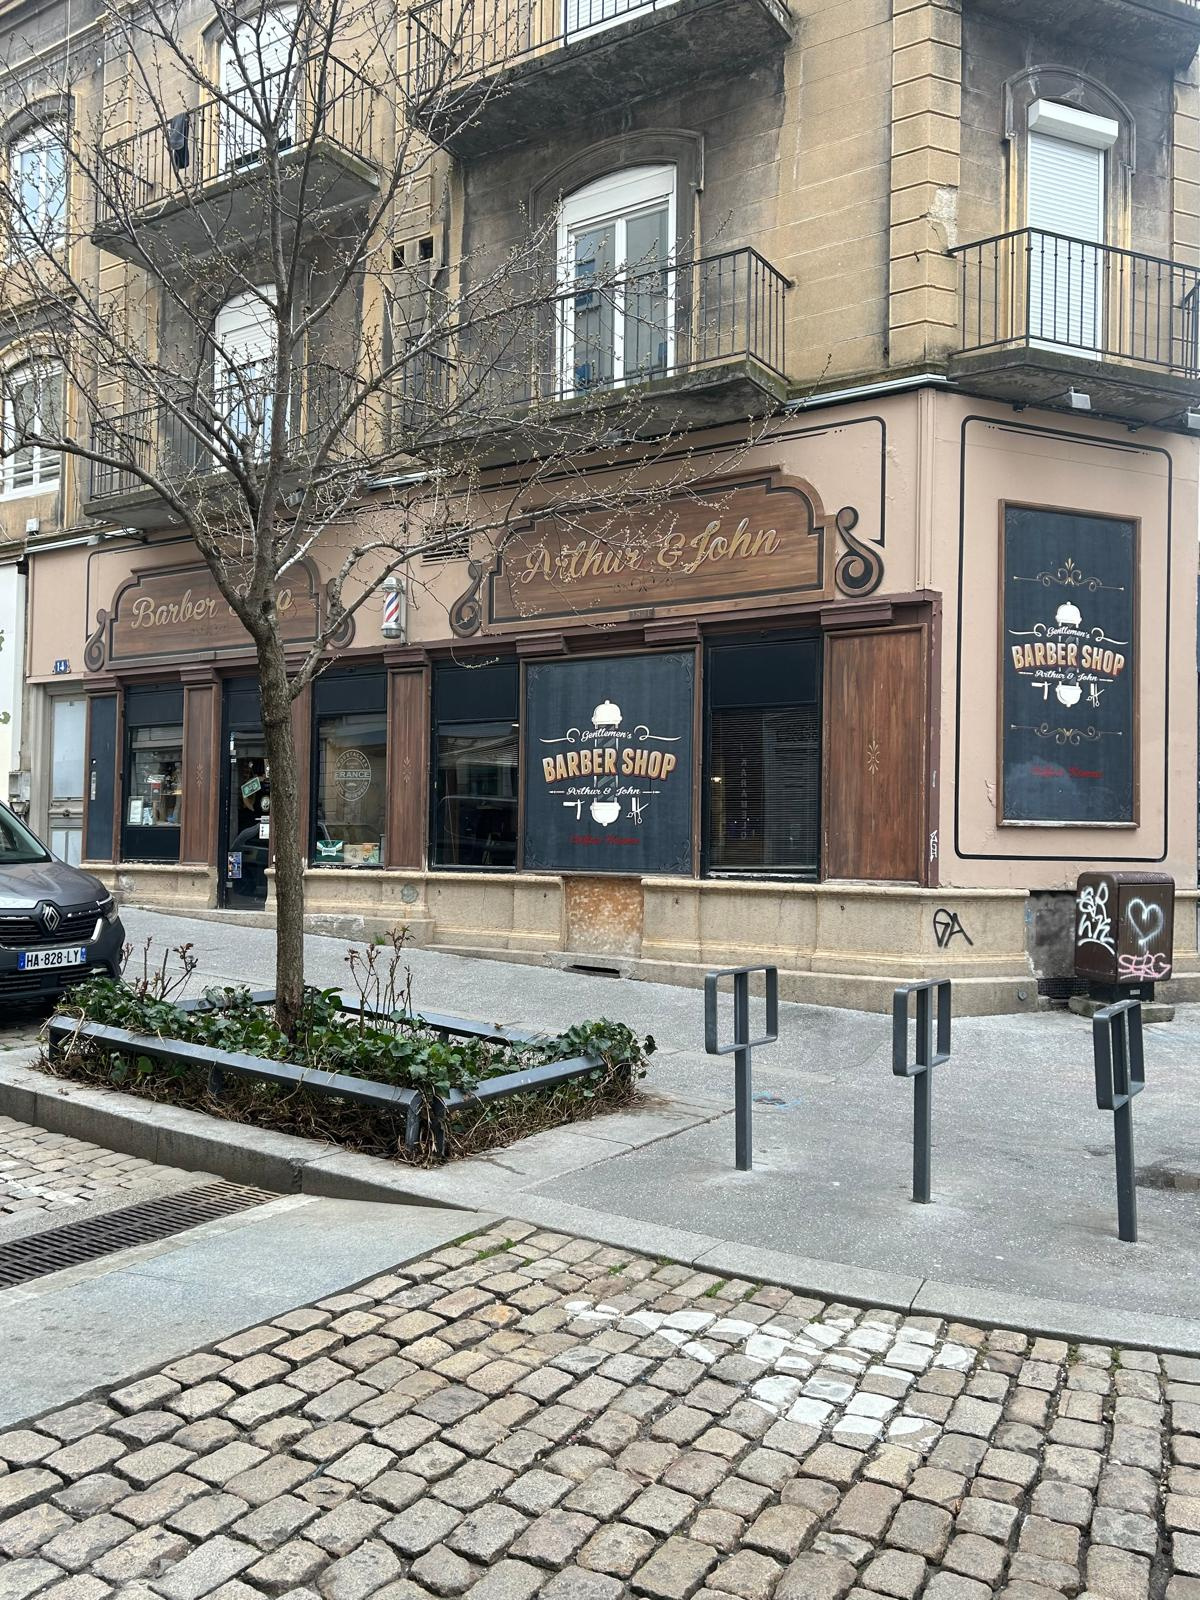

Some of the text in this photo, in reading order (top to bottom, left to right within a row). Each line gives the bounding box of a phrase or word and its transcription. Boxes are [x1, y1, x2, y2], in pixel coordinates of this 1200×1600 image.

[520, 517, 781, 584] Arthur & John
[131, 589, 218, 630] Barber
[1046, 626, 1091, 639] Gentlemen's
[1011, 642, 1125, 676] BARBER SHOP
[1034, 669, 1065, 679] Arthur
[1077, 672, 1098, 682] John
[580, 726, 632, 743] Gentlemen's
[542, 748, 677, 784] BARBER SHOP
[566, 786, 641, 796] Arthur & John
[26, 950, 79, 968] HA-828-LY
